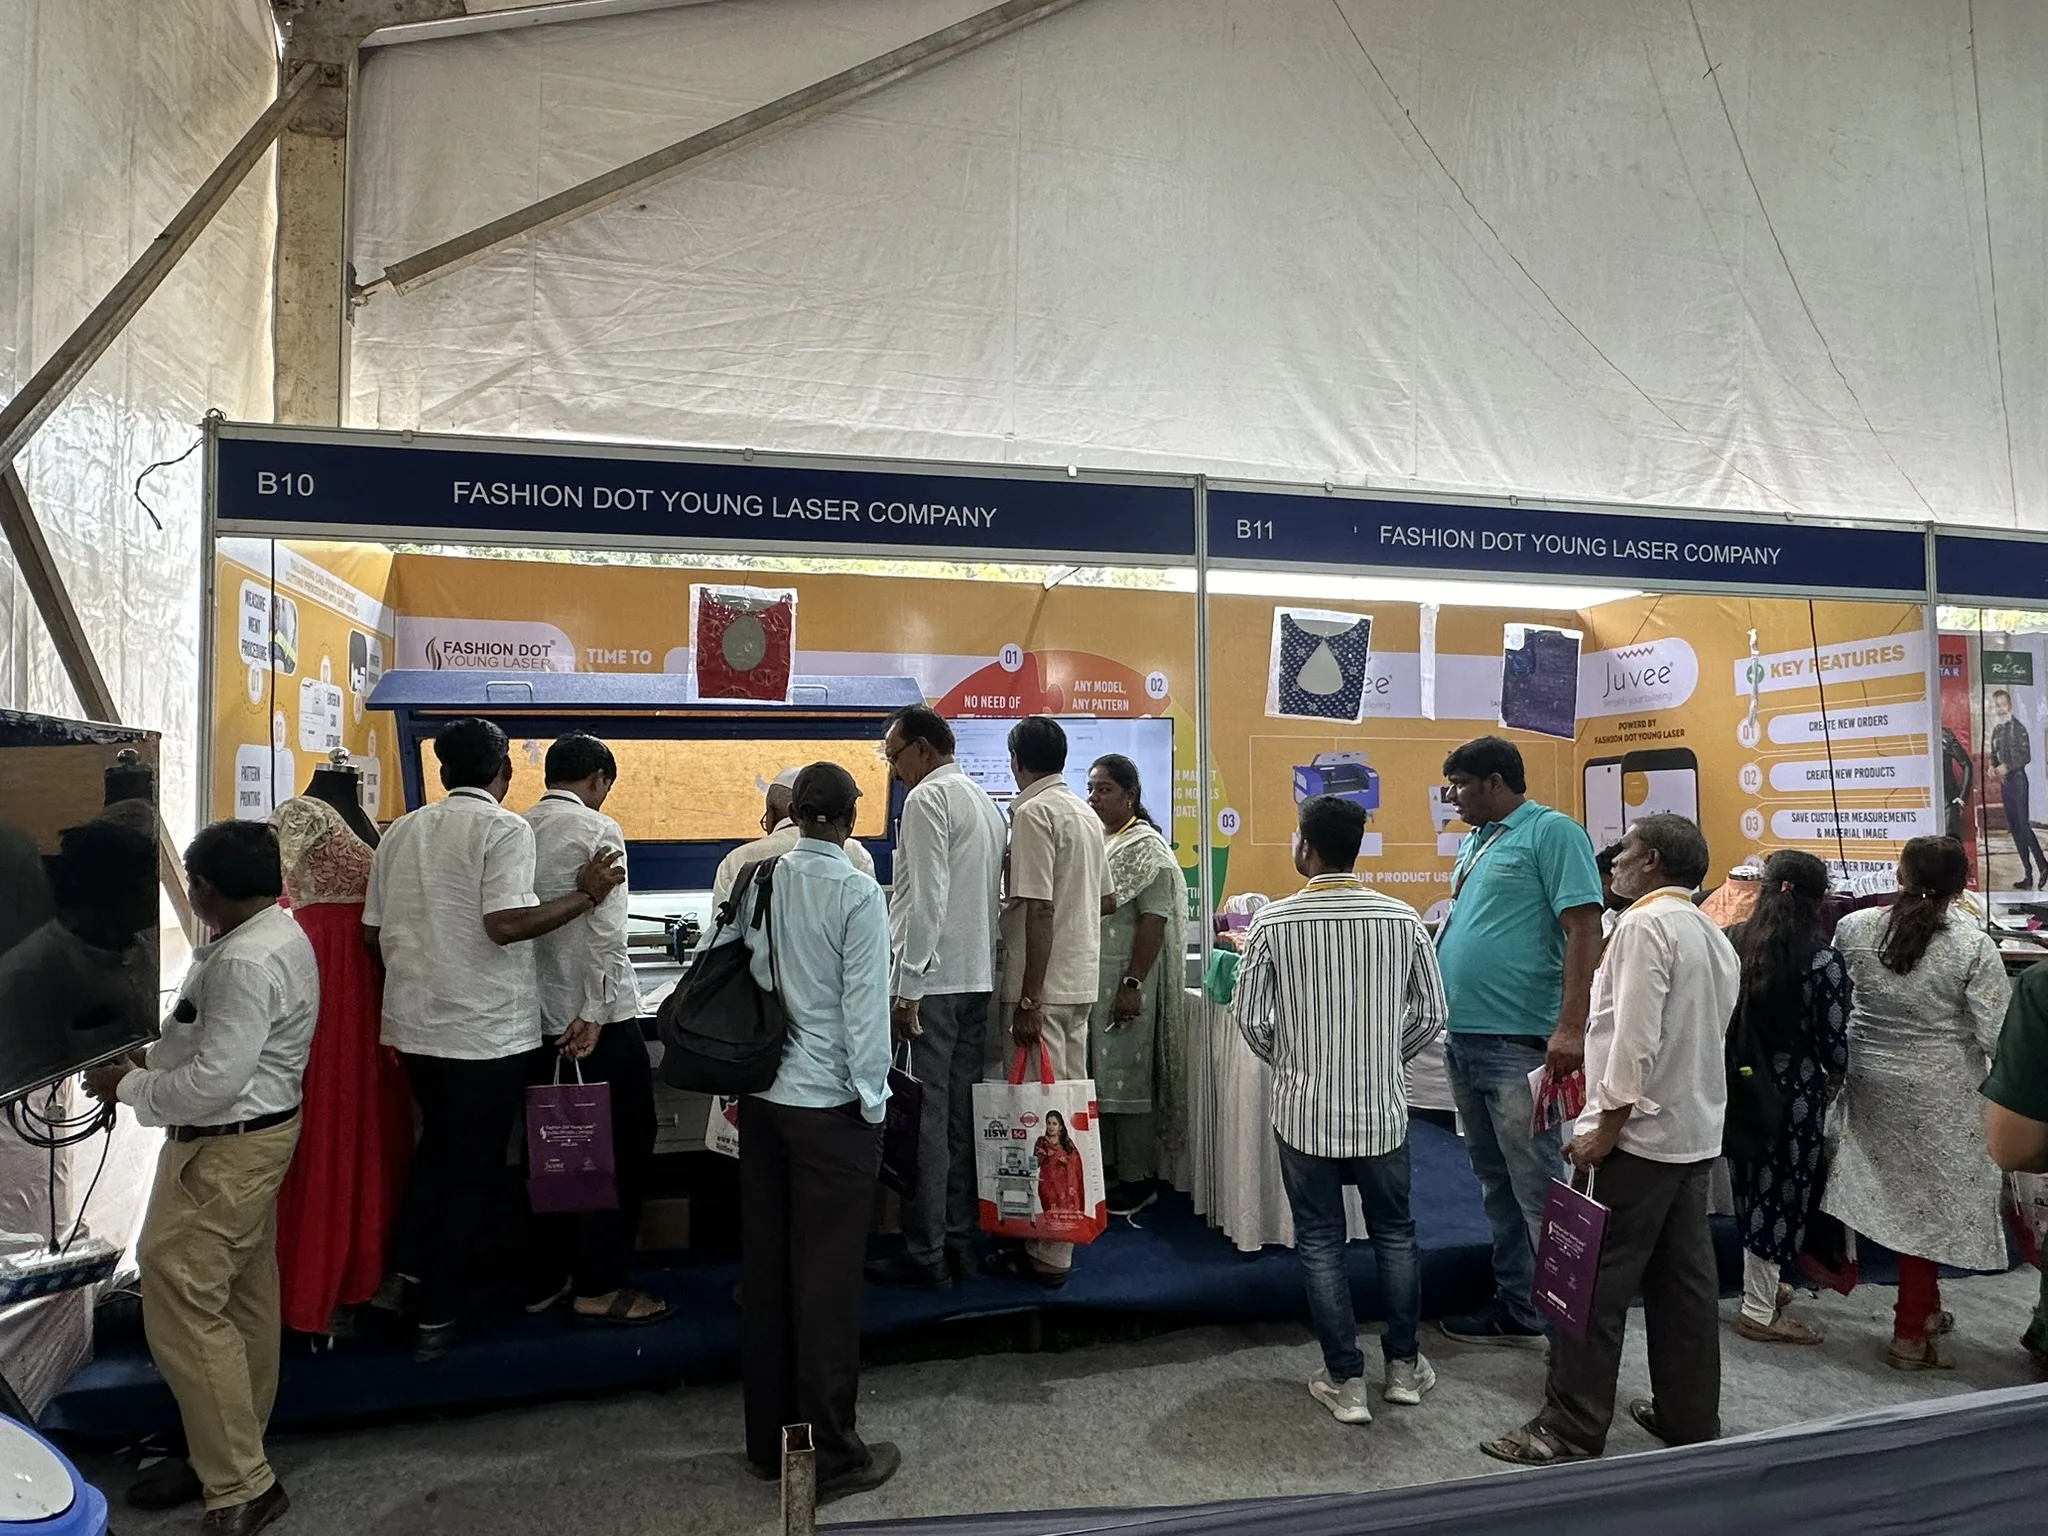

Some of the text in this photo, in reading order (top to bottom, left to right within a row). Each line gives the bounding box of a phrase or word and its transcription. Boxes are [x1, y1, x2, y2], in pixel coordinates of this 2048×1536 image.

[257, 471, 315, 497] B10
[453, 481, 997, 528] FASHION DOT YOUNG LASER COMPANY
[1236, 519, 1274, 540] B11
[1379, 525, 1782, 565] FASHION DOT YOUNG LASER COMPANY
[244, 589, 266, 613] MEASURE
[241, 638, 268, 662] PROCEDURE
[443, 641, 551, 657] FASHION DOT
[586, 648, 653, 666] TIME TO
[444, 655, 550, 669] YOUNG LASER
[1004, 650, 1018, 665] 01
[1770, 644, 1905, 679] KEY FEATURES
[1074, 680, 1127, 695] ANY MODEL,
[1150, 677, 1163, 692] 02
[1602, 661, 1671, 698] Juvee
[964, 695, 1021, 709] NO NEED OF
[1072, 698, 1129, 711] ANY PATTERN
[1647, 718, 1657, 728] BY
[1838, 718, 1855, 730] NEW
[1857, 714, 1889, 727] ORDERS
[1594, 728, 1686, 744] FASHION DOT YOUNG LASER
[241, 765, 261, 782] PATTERN
[1744, 769, 1757, 785] 02
[1806, 766, 1896, 781] CREATE NEW PRODUCTS
[240, 790, 261, 807] PRINTING
[1222, 814, 1235, 828] 03
[1745, 816, 1759, 831] 03
[1791, 812, 1809, 823] SAVE
[1851, 811, 1917, 823] MEASUREMENTS
[1816, 828, 1888, 839] & MATERIAL IMAGE
[1860, 861, 1885, 872] TRACK
[1376, 871, 1431, 883] PRODUCT
